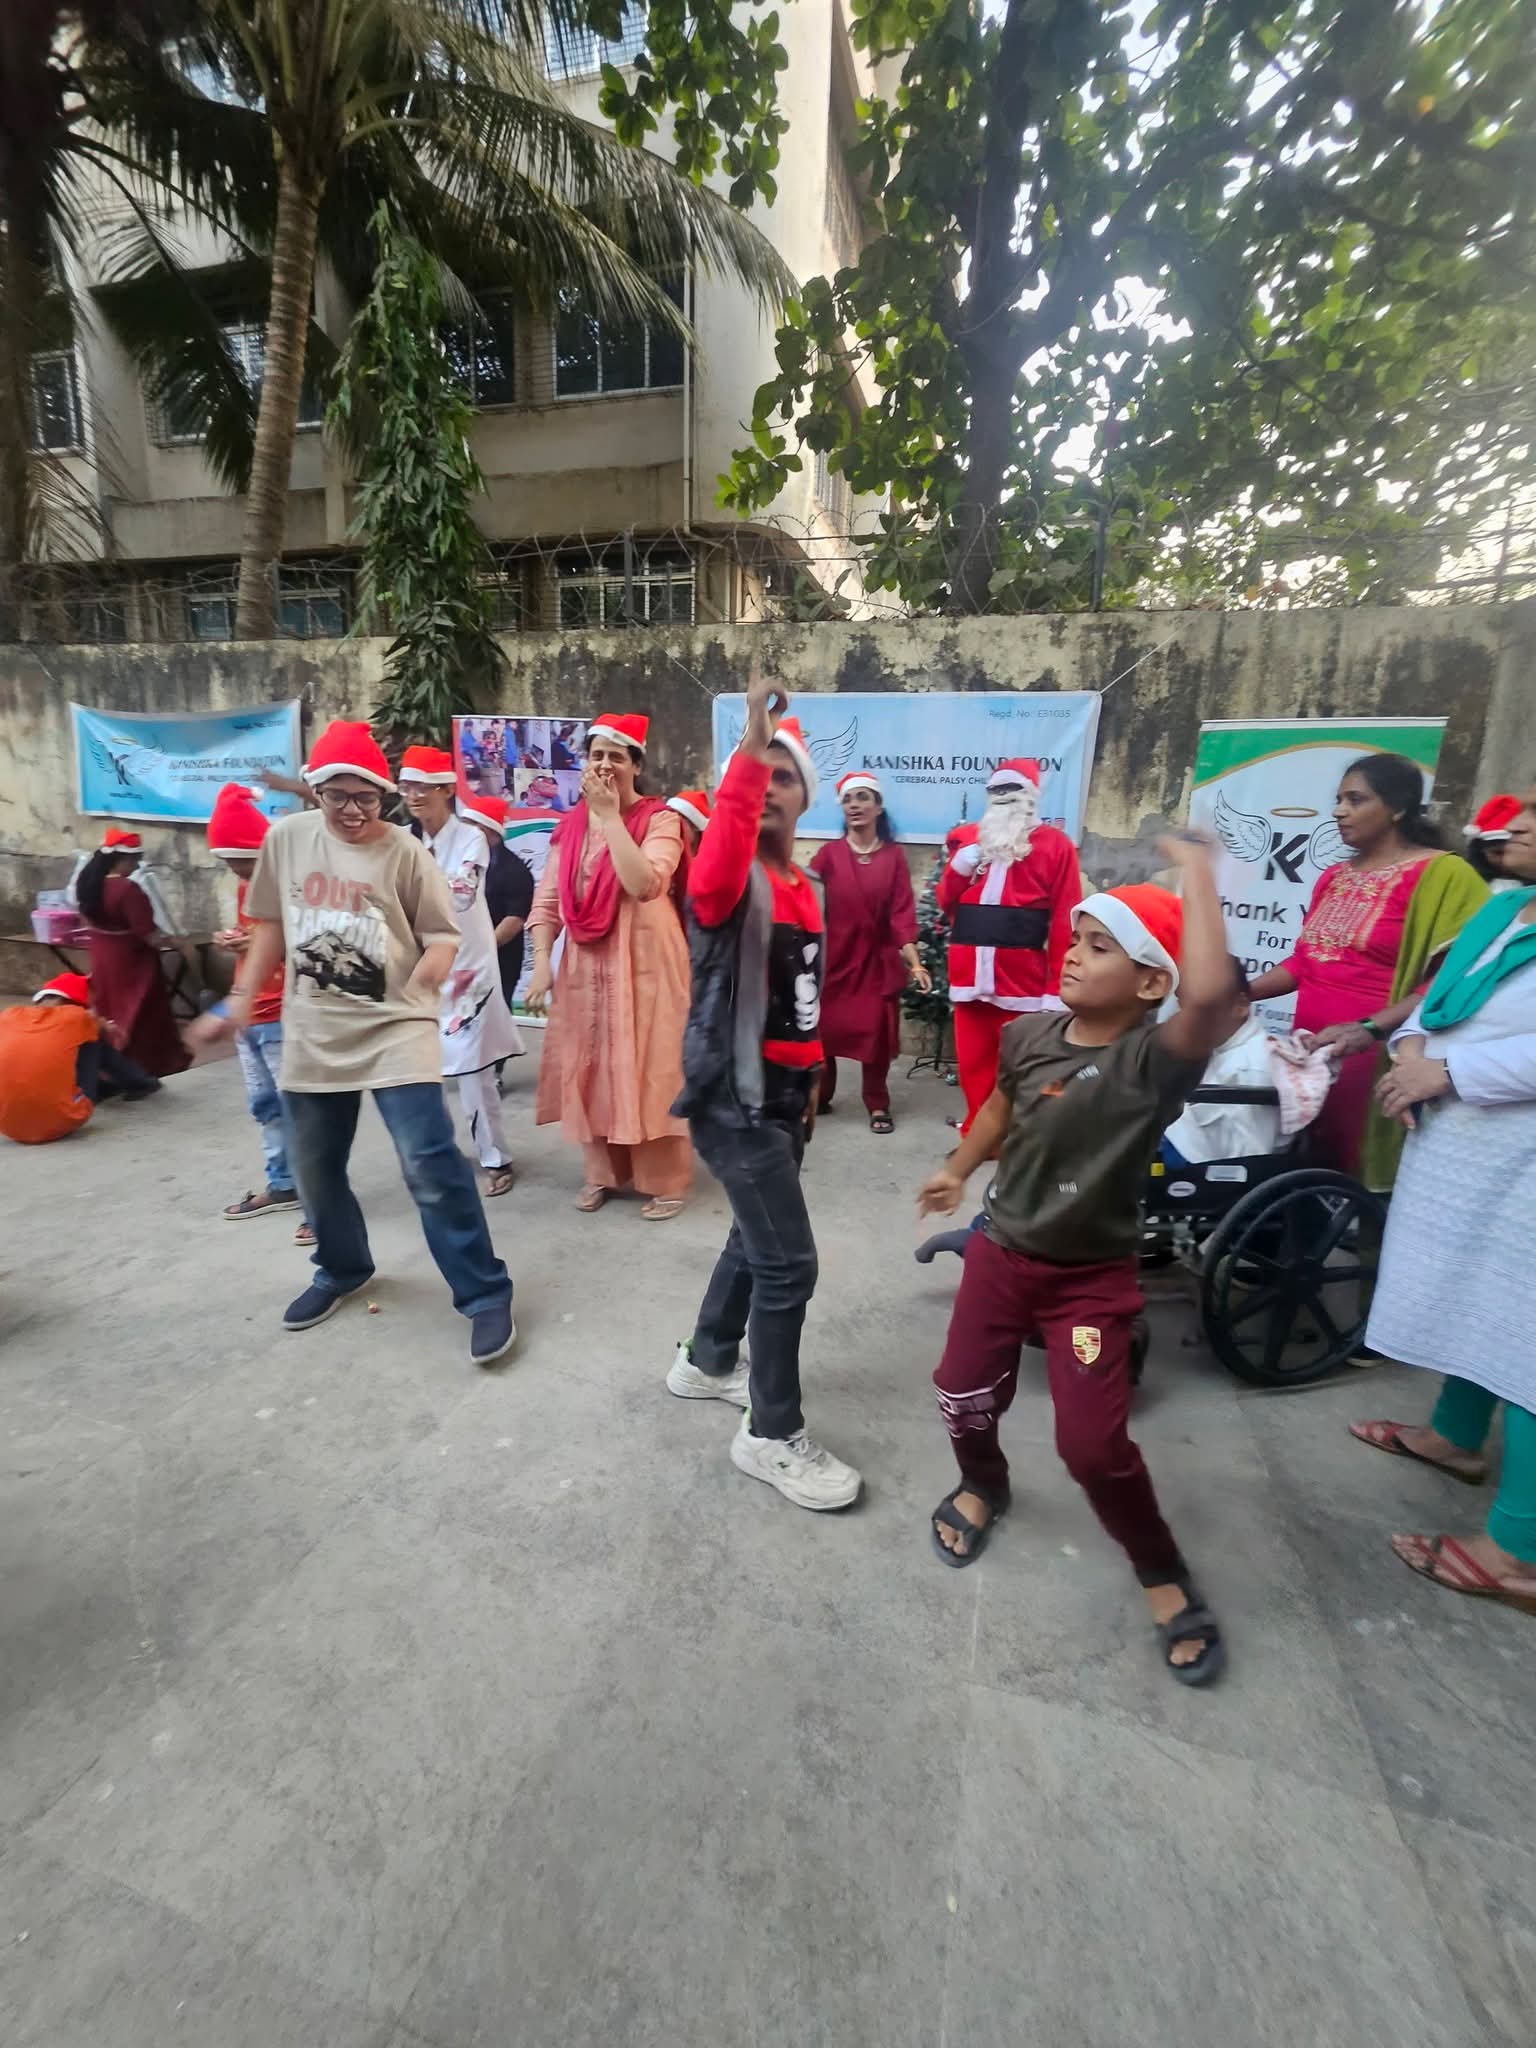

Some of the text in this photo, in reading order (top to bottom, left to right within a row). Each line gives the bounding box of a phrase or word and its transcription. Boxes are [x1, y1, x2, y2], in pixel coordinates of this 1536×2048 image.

[863, 755, 944, 770] KANISHKA
[940, 776, 966, 785] PALSY
[303, 871, 374, 913] OUT
[1220, 895, 1288, 924] hank
[1256, 930, 1292, 949] For
